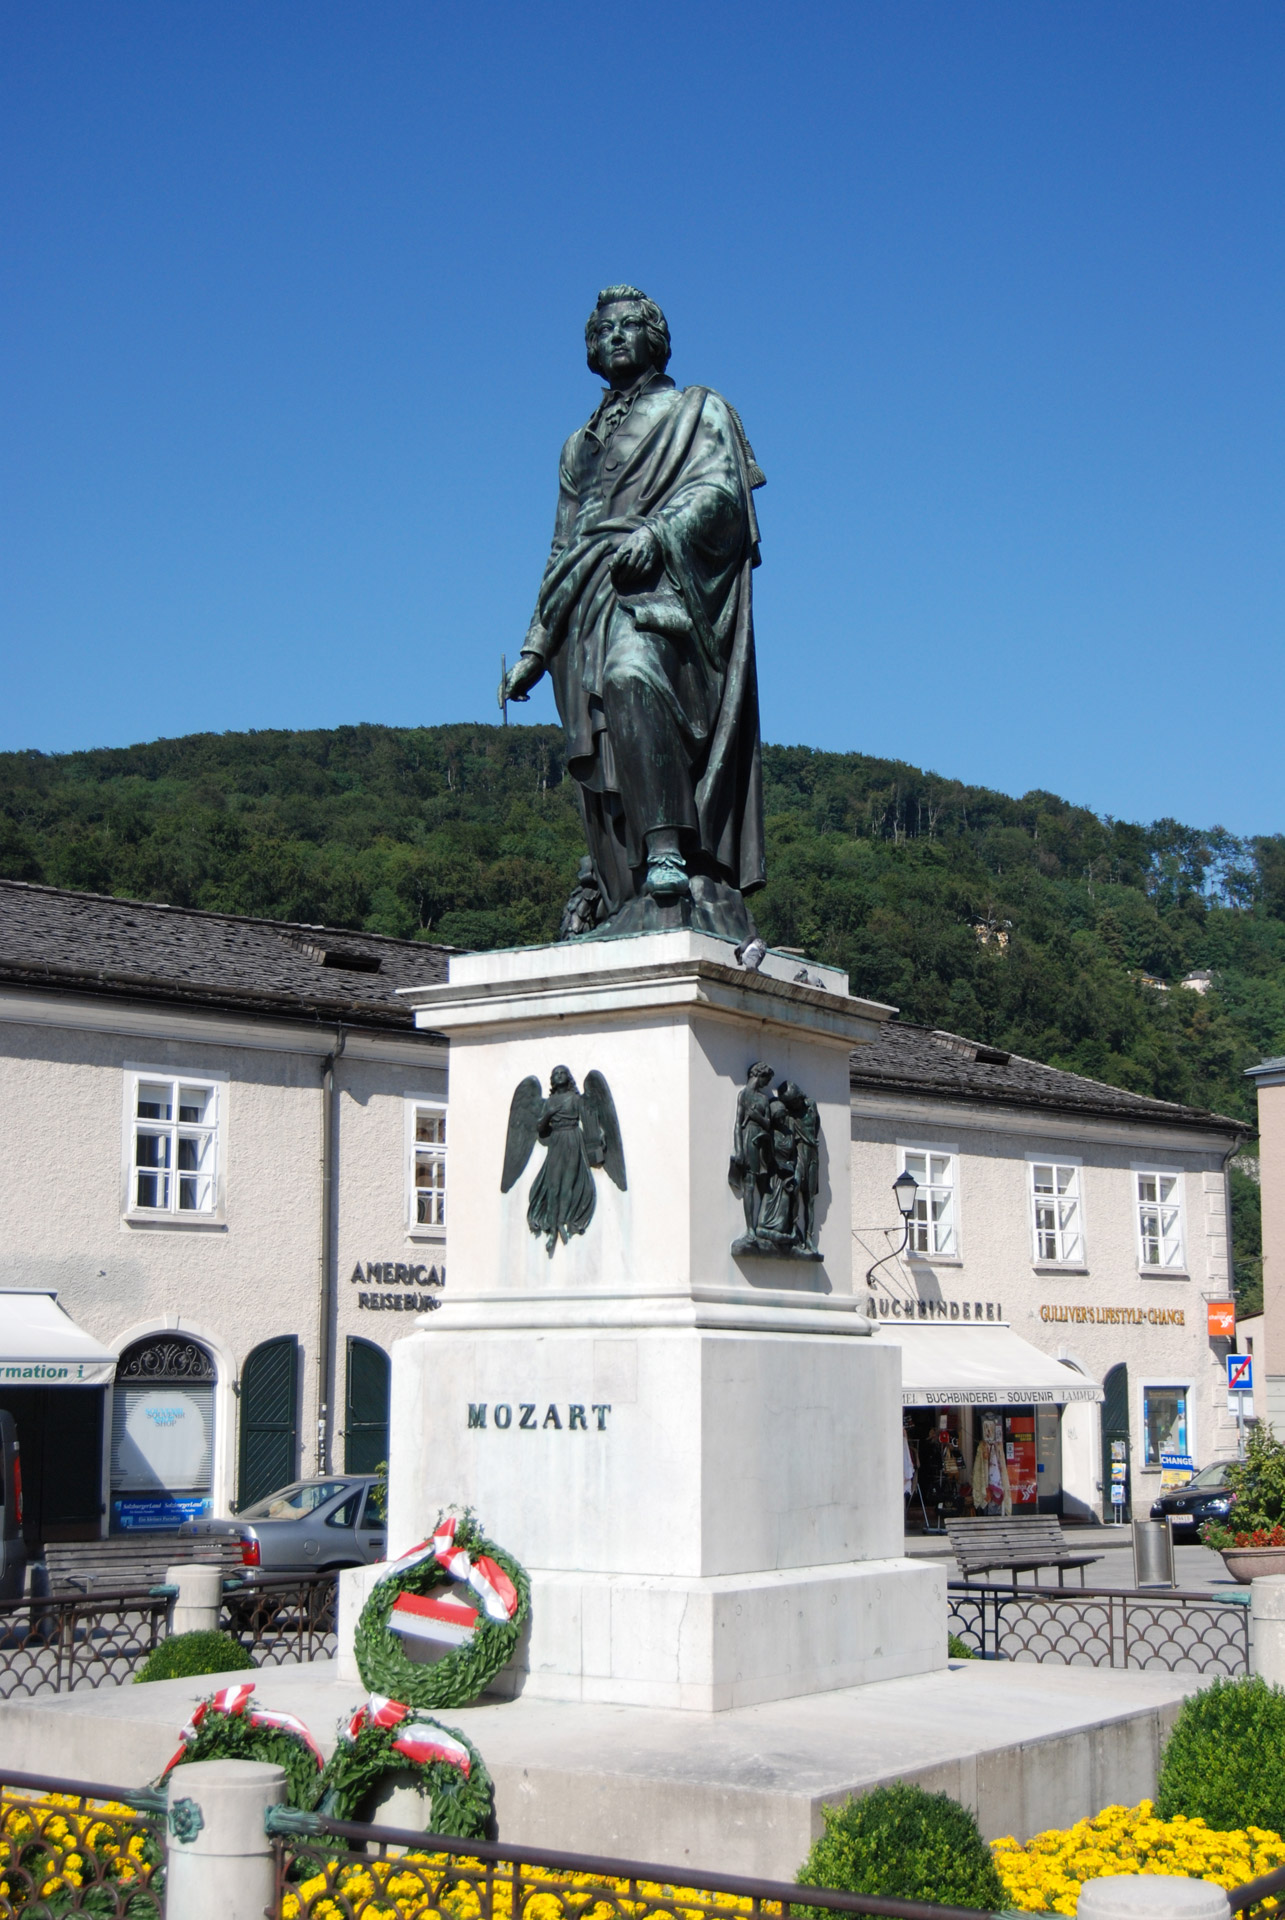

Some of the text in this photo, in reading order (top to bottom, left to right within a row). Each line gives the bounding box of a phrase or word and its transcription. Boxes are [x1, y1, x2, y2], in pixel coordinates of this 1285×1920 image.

[1040, 1304, 1095, 1324] GULLIVER'S
[1095, 1306, 1143, 1325] LIFESTYLE
[1147, 1307, 1186, 1326] CHANGE
[926, 1392, 998, 1404] BUCHBINDEREI
[1007, 1391, 1053, 1403] SOUVENIR
[467, 1403, 612, 1431] MOZART
[1161, 1456, 1193, 1466] CHANGE
